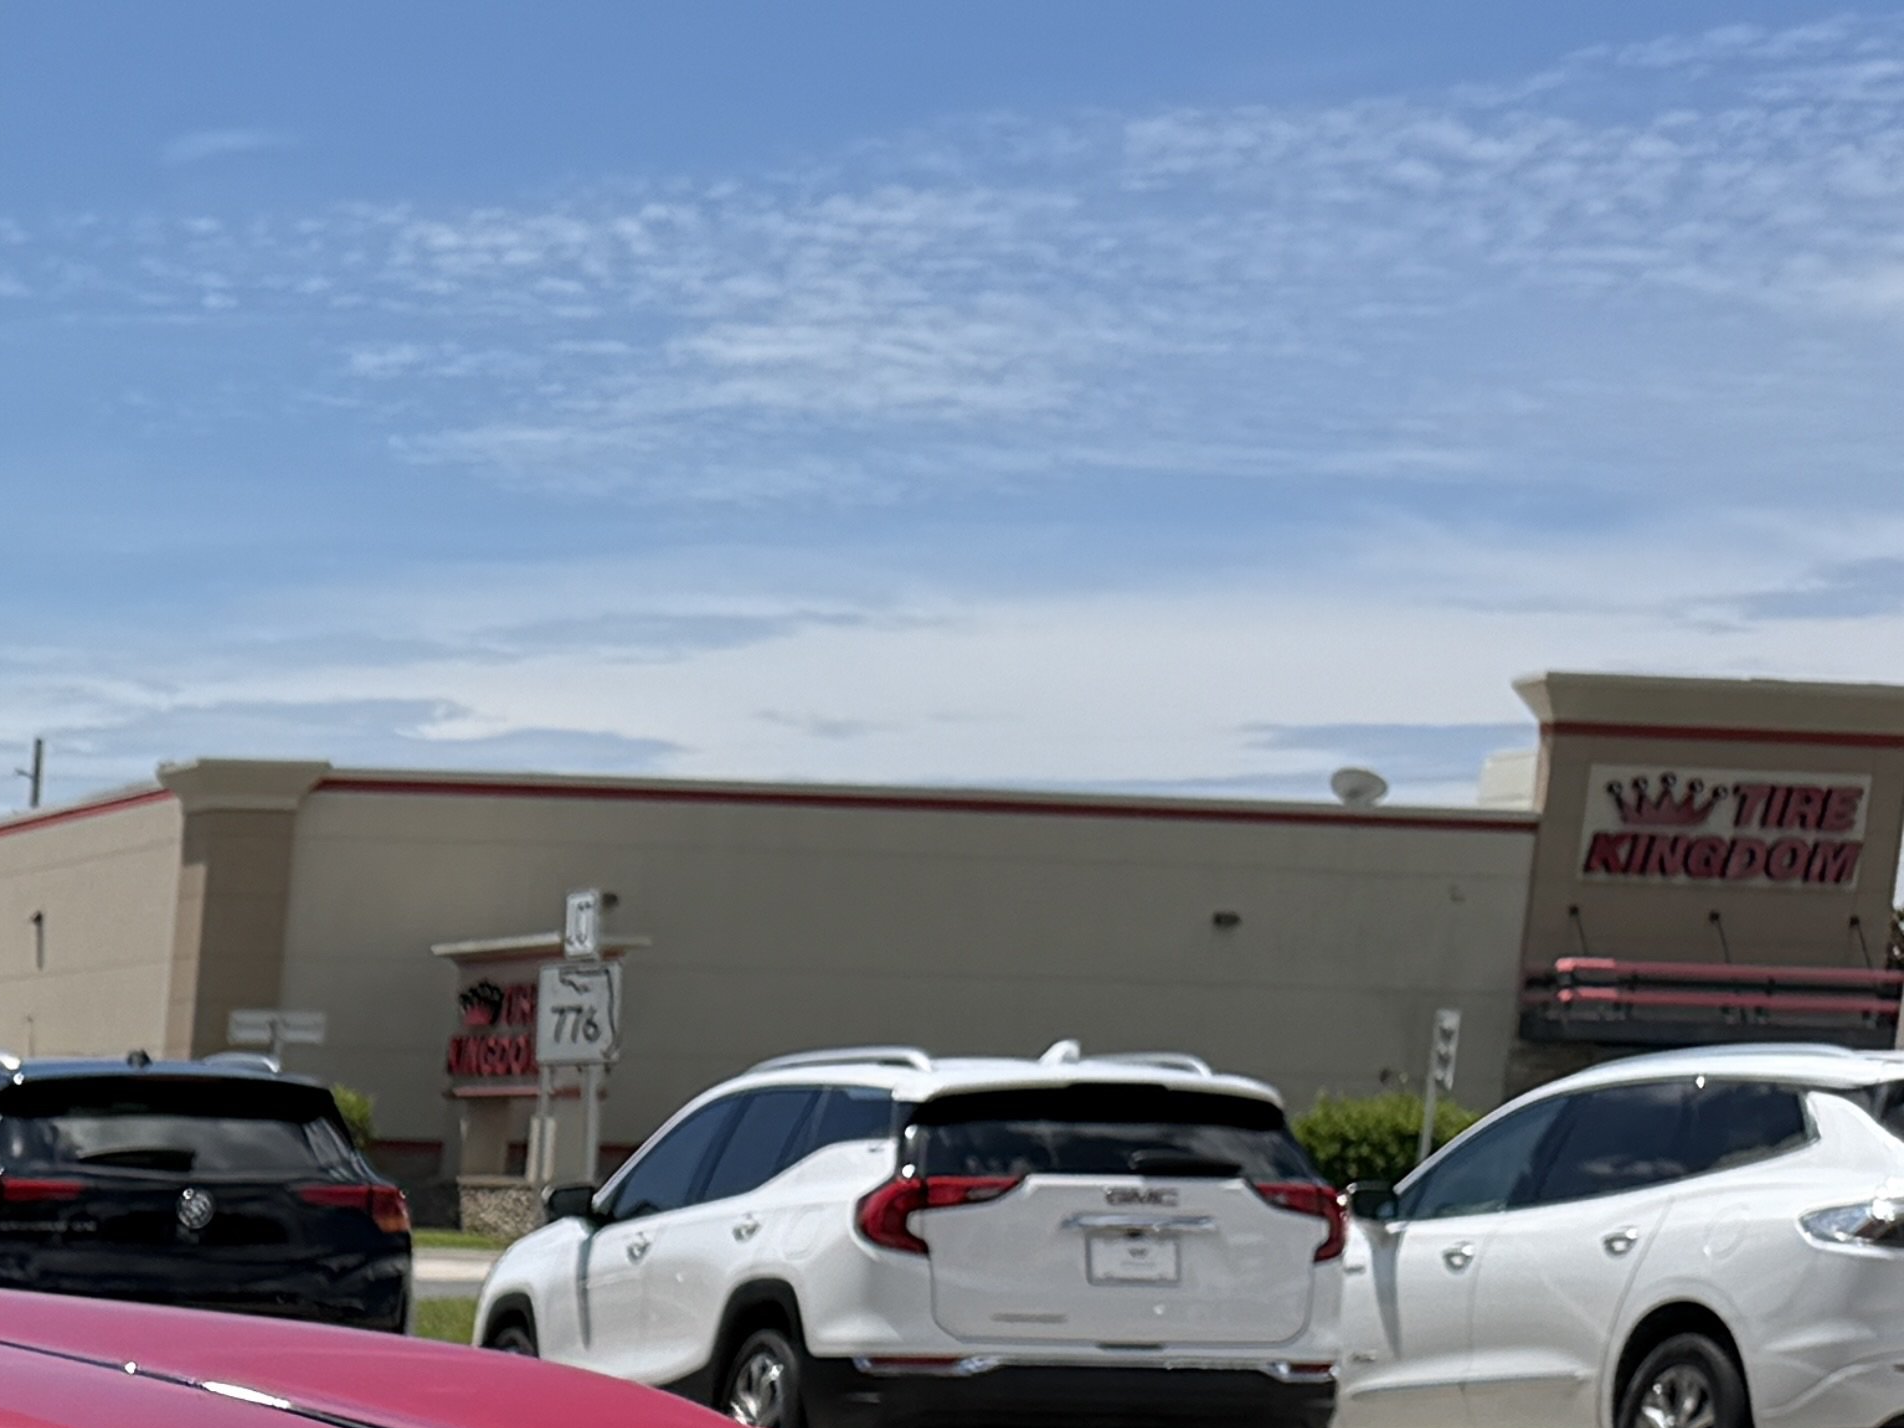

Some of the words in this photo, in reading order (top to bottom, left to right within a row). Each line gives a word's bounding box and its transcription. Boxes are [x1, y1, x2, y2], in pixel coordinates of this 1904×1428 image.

[1732, 782, 1865, 832] TIRE
[1582, 831, 1863, 884] KINGDOM
[551, 1006, 602, 1043] 776
[1104, 1187, 1179, 1207] GMC
